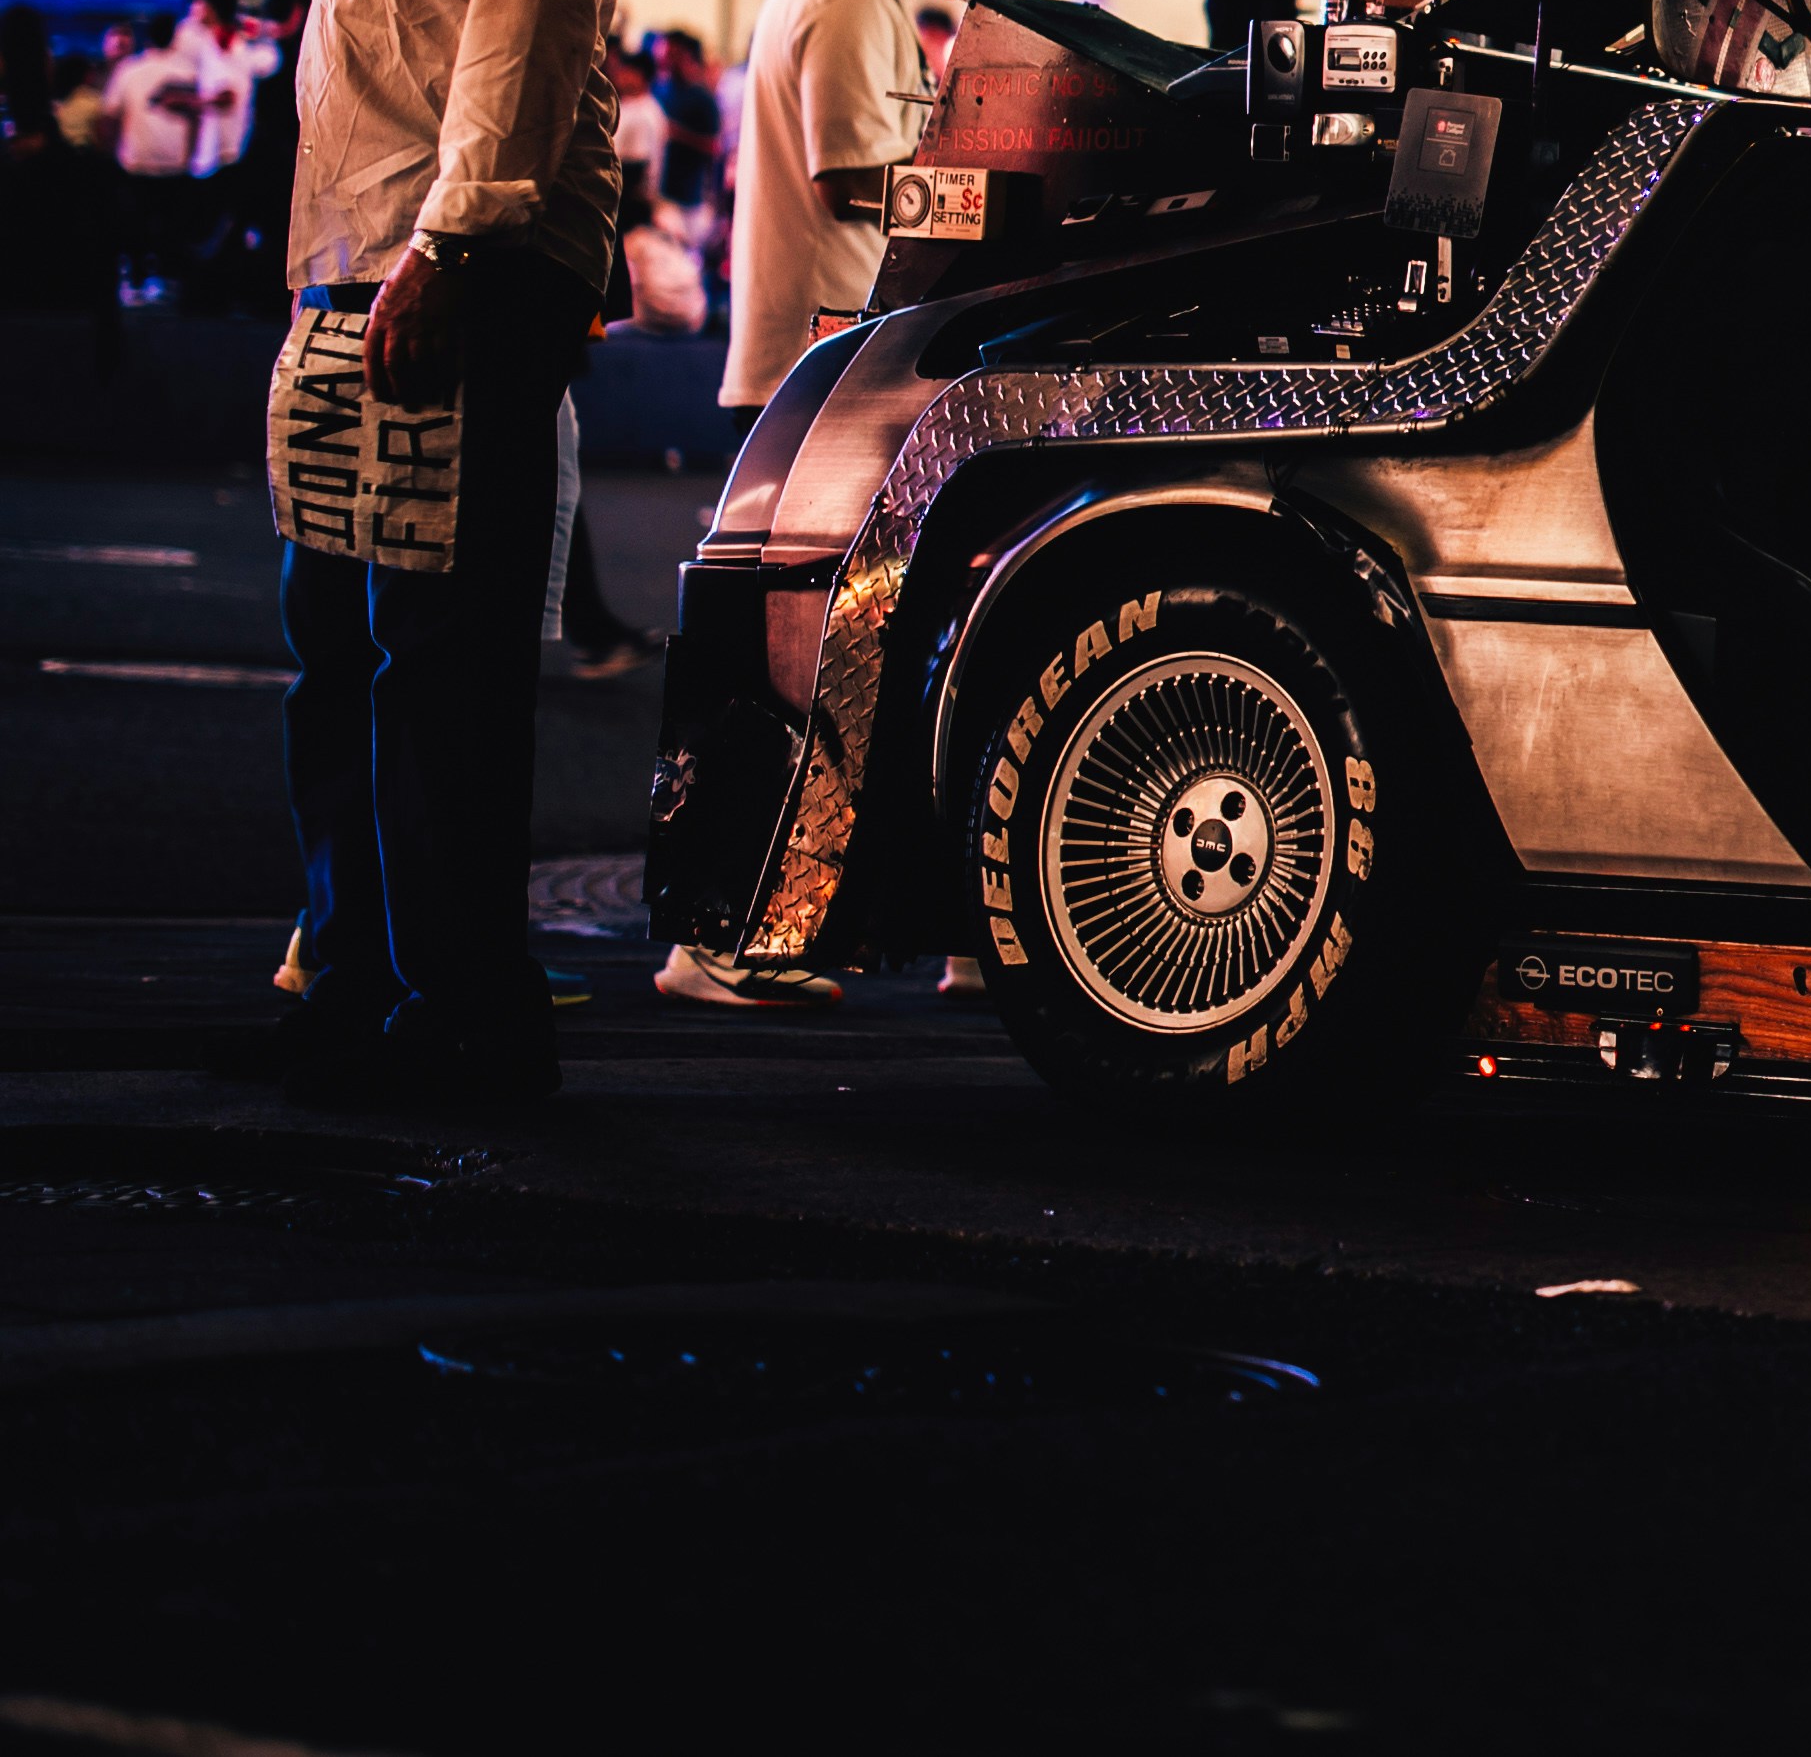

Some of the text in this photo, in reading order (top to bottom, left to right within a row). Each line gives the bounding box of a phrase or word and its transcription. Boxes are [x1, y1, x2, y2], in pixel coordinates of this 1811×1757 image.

[938, 127, 1034, 152] FISSION
[939, 172, 975, 187] TIMER
[932, 211, 982, 226] SETTING
[287, 310, 371, 552] DONATE
[981, 589, 1162, 966] DELOREAN
[1558, 964, 1674, 994] ECOTEC
